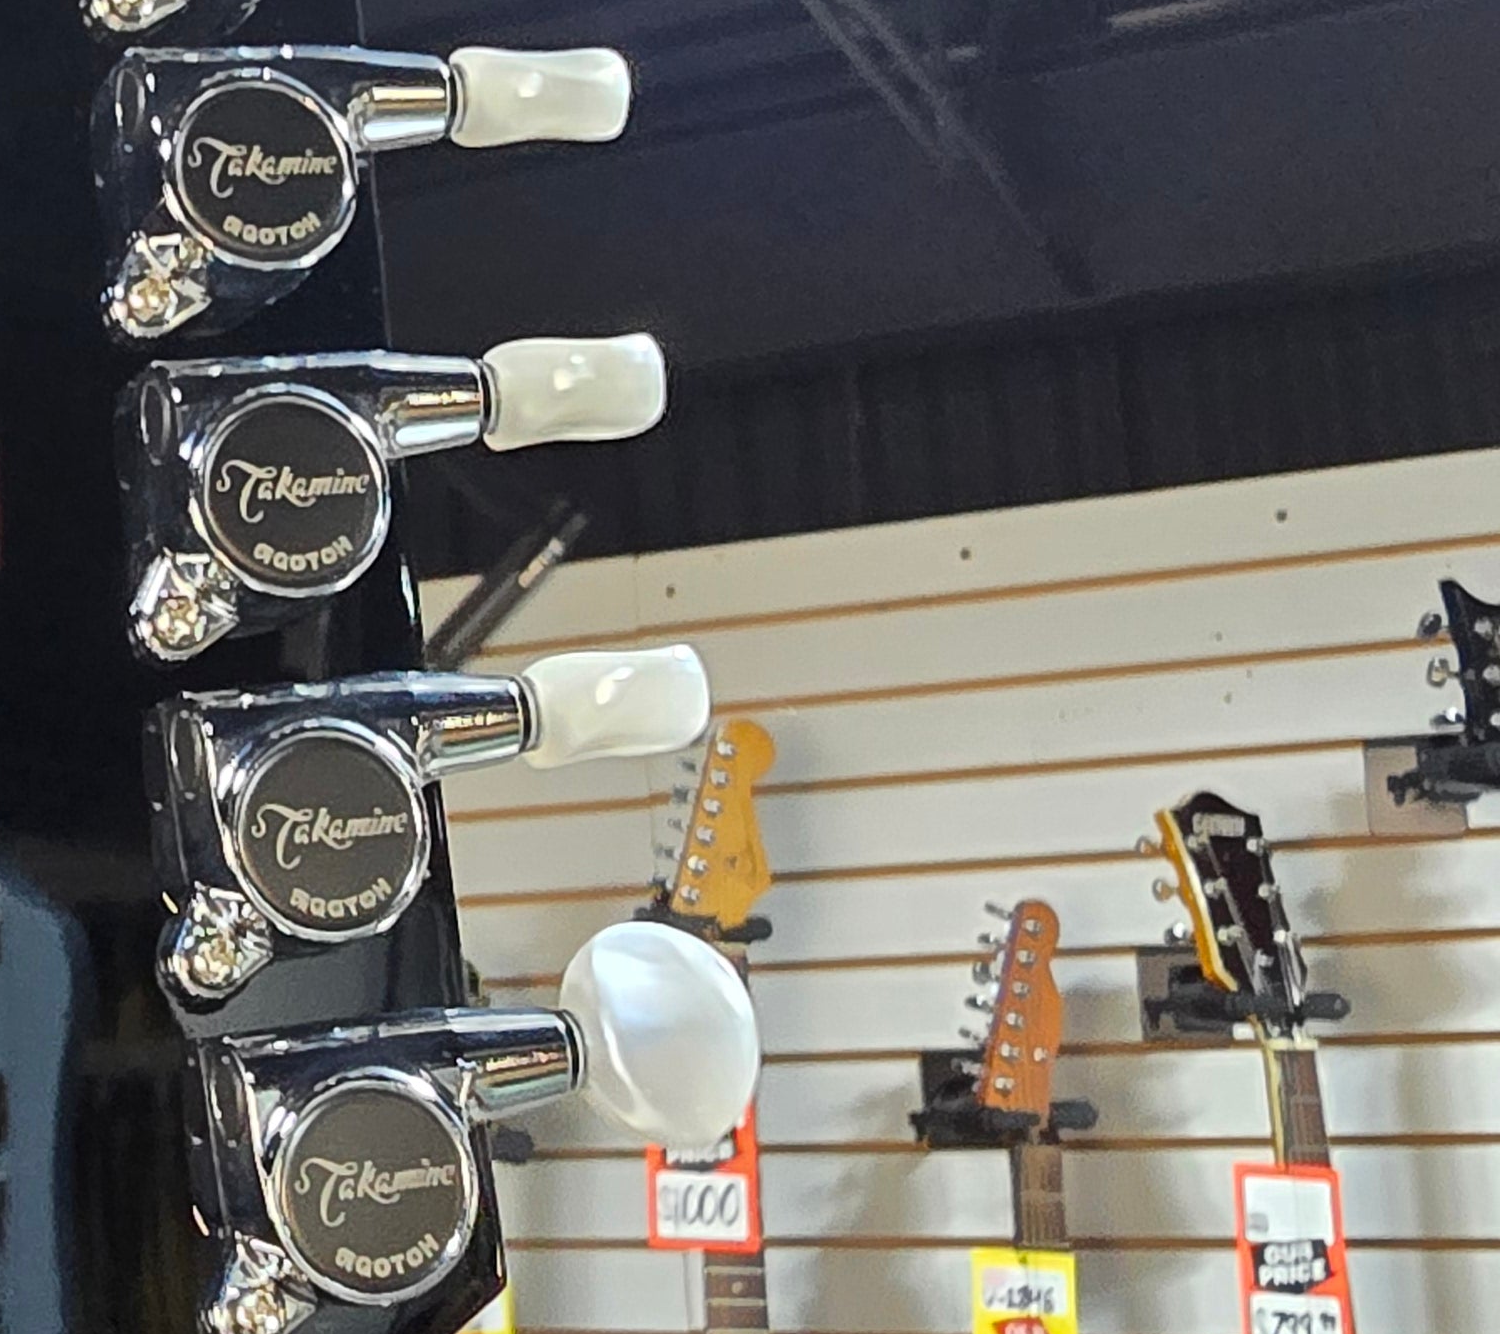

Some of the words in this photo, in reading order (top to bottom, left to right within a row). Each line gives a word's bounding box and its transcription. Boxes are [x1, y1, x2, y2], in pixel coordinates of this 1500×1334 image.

[189, 136, 338, 199] Takamine
[216, 459, 370, 523] Takamine
[250, 803, 408, 870] Takamine
[294, 1157, 456, 1228] Takamine
